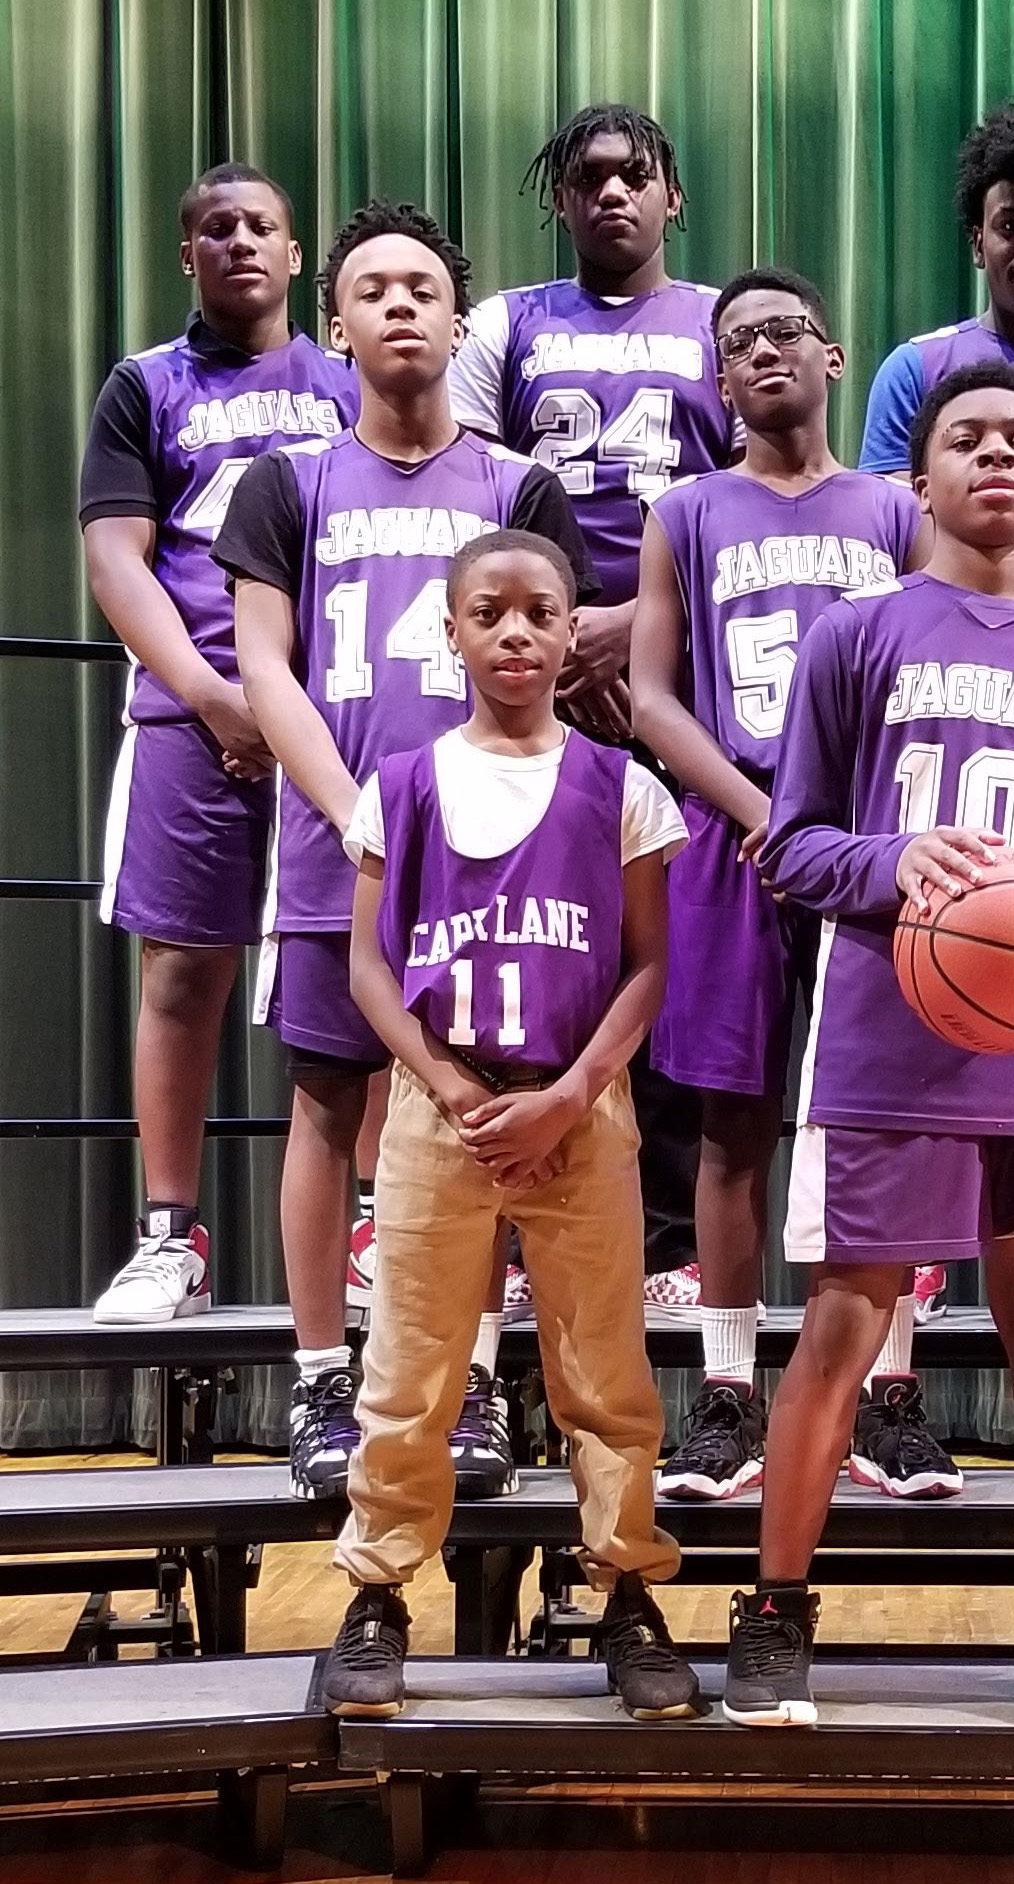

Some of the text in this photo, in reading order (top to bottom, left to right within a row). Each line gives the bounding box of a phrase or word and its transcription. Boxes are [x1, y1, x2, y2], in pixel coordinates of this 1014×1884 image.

[521, 333, 702, 382] JAGUARS
[177, 389, 343, 452] JAGUARS
[530, 387, 682, 495] 24
[315, 507, 500, 566] JAGUAR
[712, 535, 897, 605] JAGUARS
[324, 578, 467, 703] 14
[725, 609, 799, 740] 5
[494, 894, 590, 953] LANE
[448, 958, 526, 1046] 11
